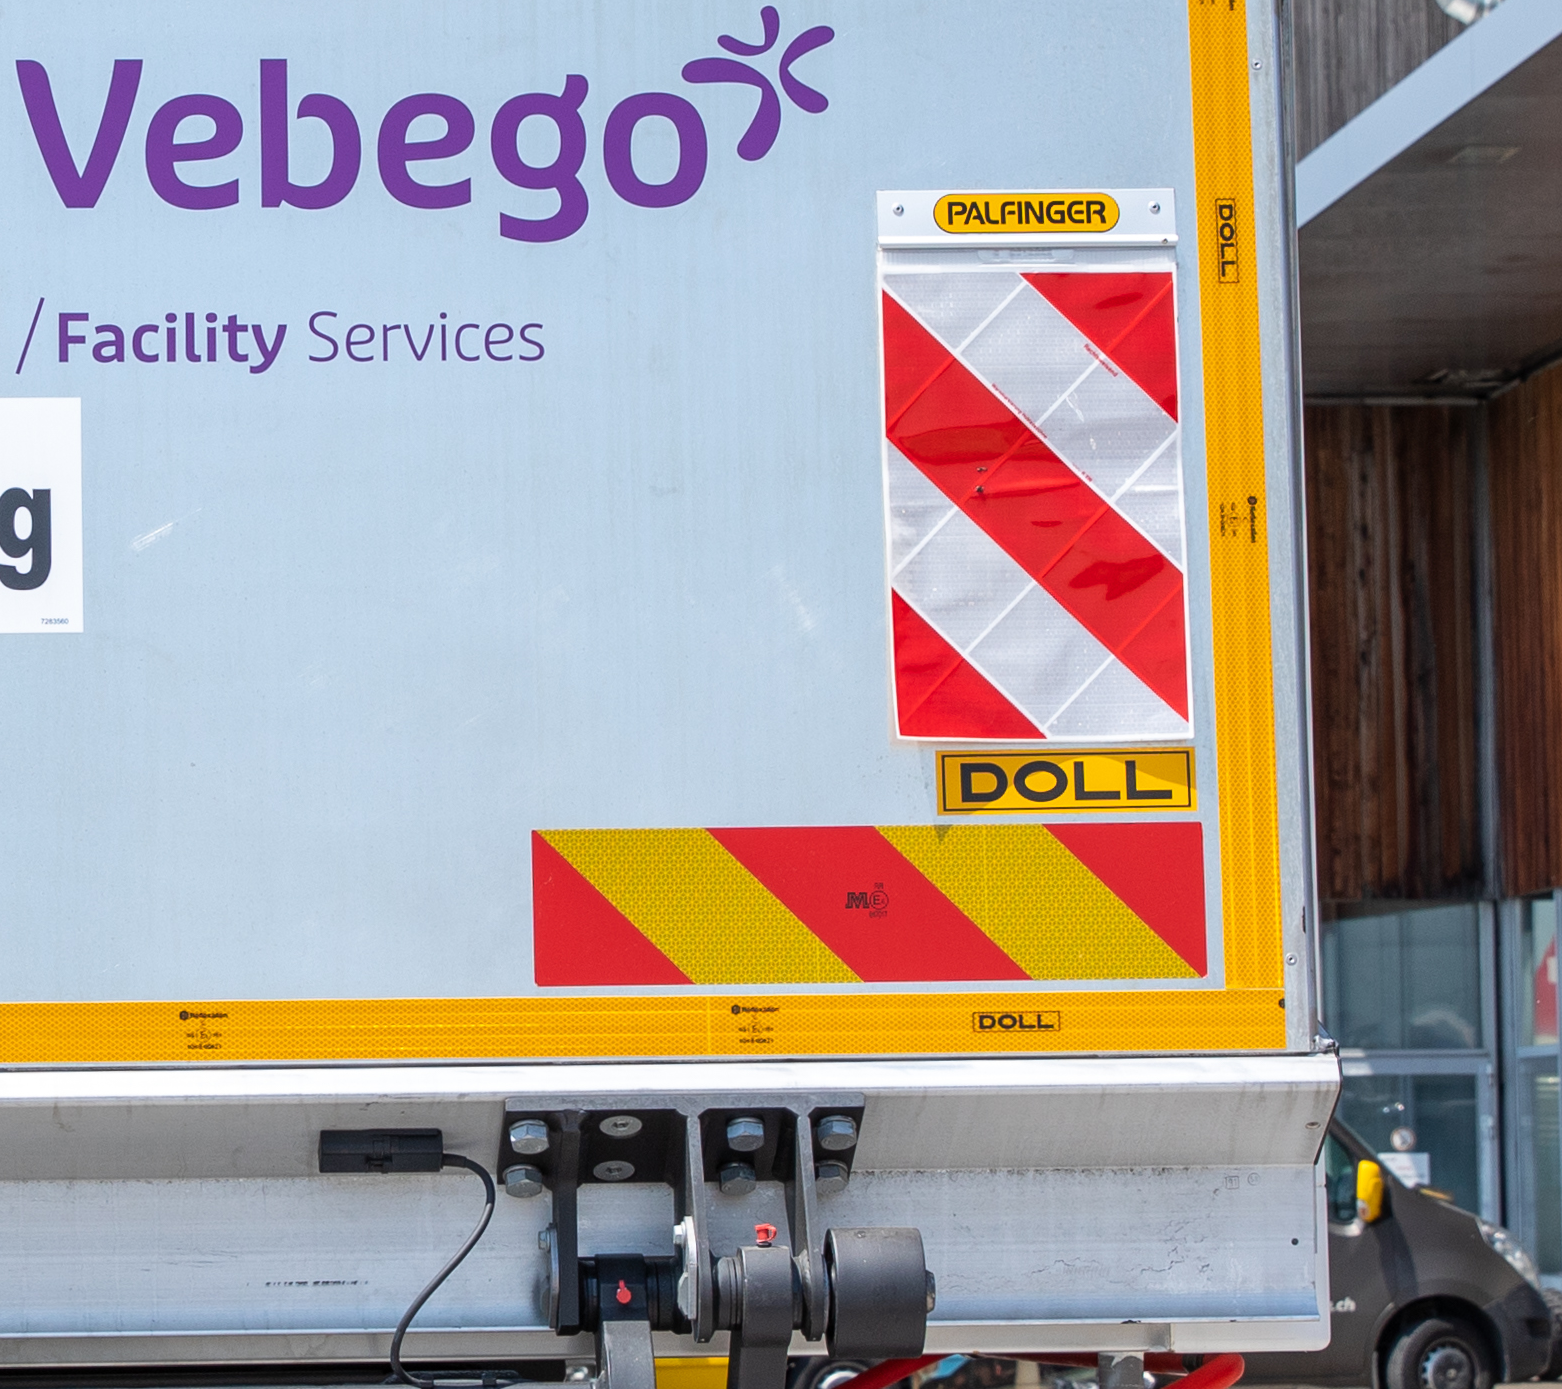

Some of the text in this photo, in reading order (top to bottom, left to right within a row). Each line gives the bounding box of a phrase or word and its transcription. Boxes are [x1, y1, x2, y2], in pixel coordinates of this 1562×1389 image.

[16, 58, 709, 243] Vebego
[947, 200, 1107, 226] PALFINGER
[1219, 203, 1236, 278] DOLL
[309, 312, 544, 363] Services
[961, 760, 1173, 803] DOLL
[978, 1013, 1055, 1030] DOLL
